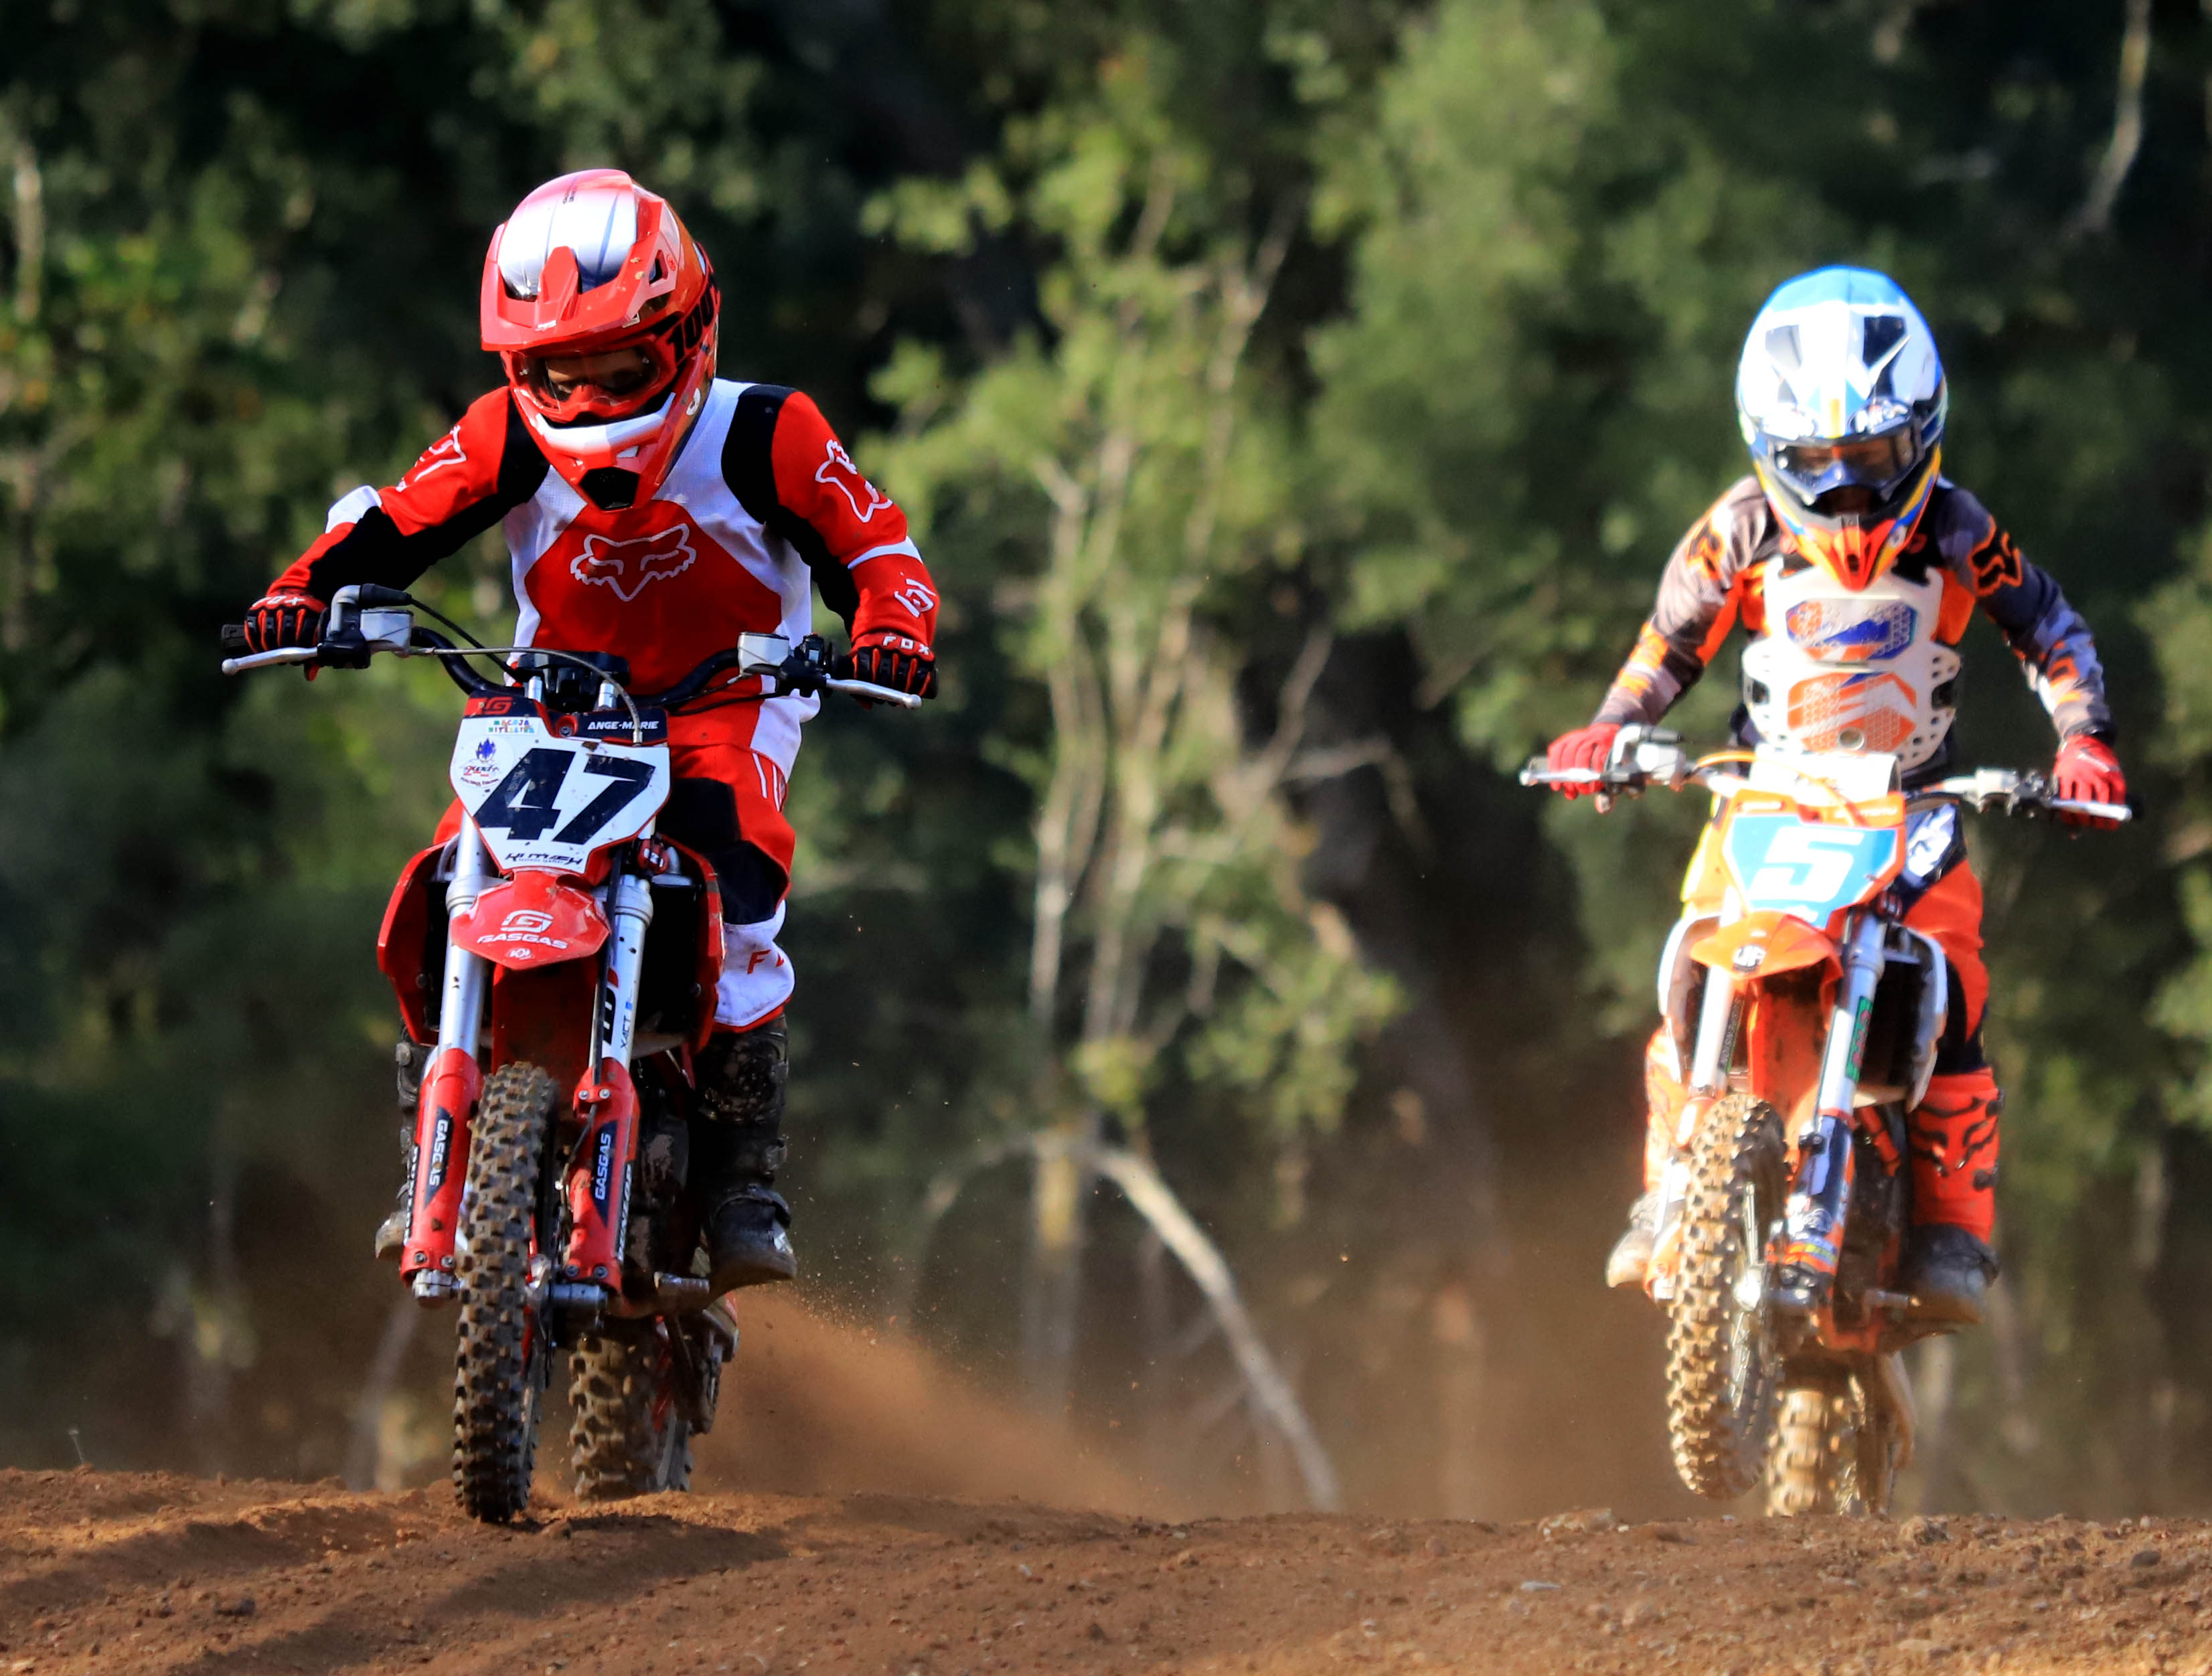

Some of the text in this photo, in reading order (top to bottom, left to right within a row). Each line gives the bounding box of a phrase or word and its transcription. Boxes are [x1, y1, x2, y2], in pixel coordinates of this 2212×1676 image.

[882, 635, 930, 655] FOX
[472, 747, 655, 845] 47
[1747, 826, 1865, 903] 5
[476, 933, 568, 950] GASGAS
[595, 1133, 612, 1201] GASGAS
